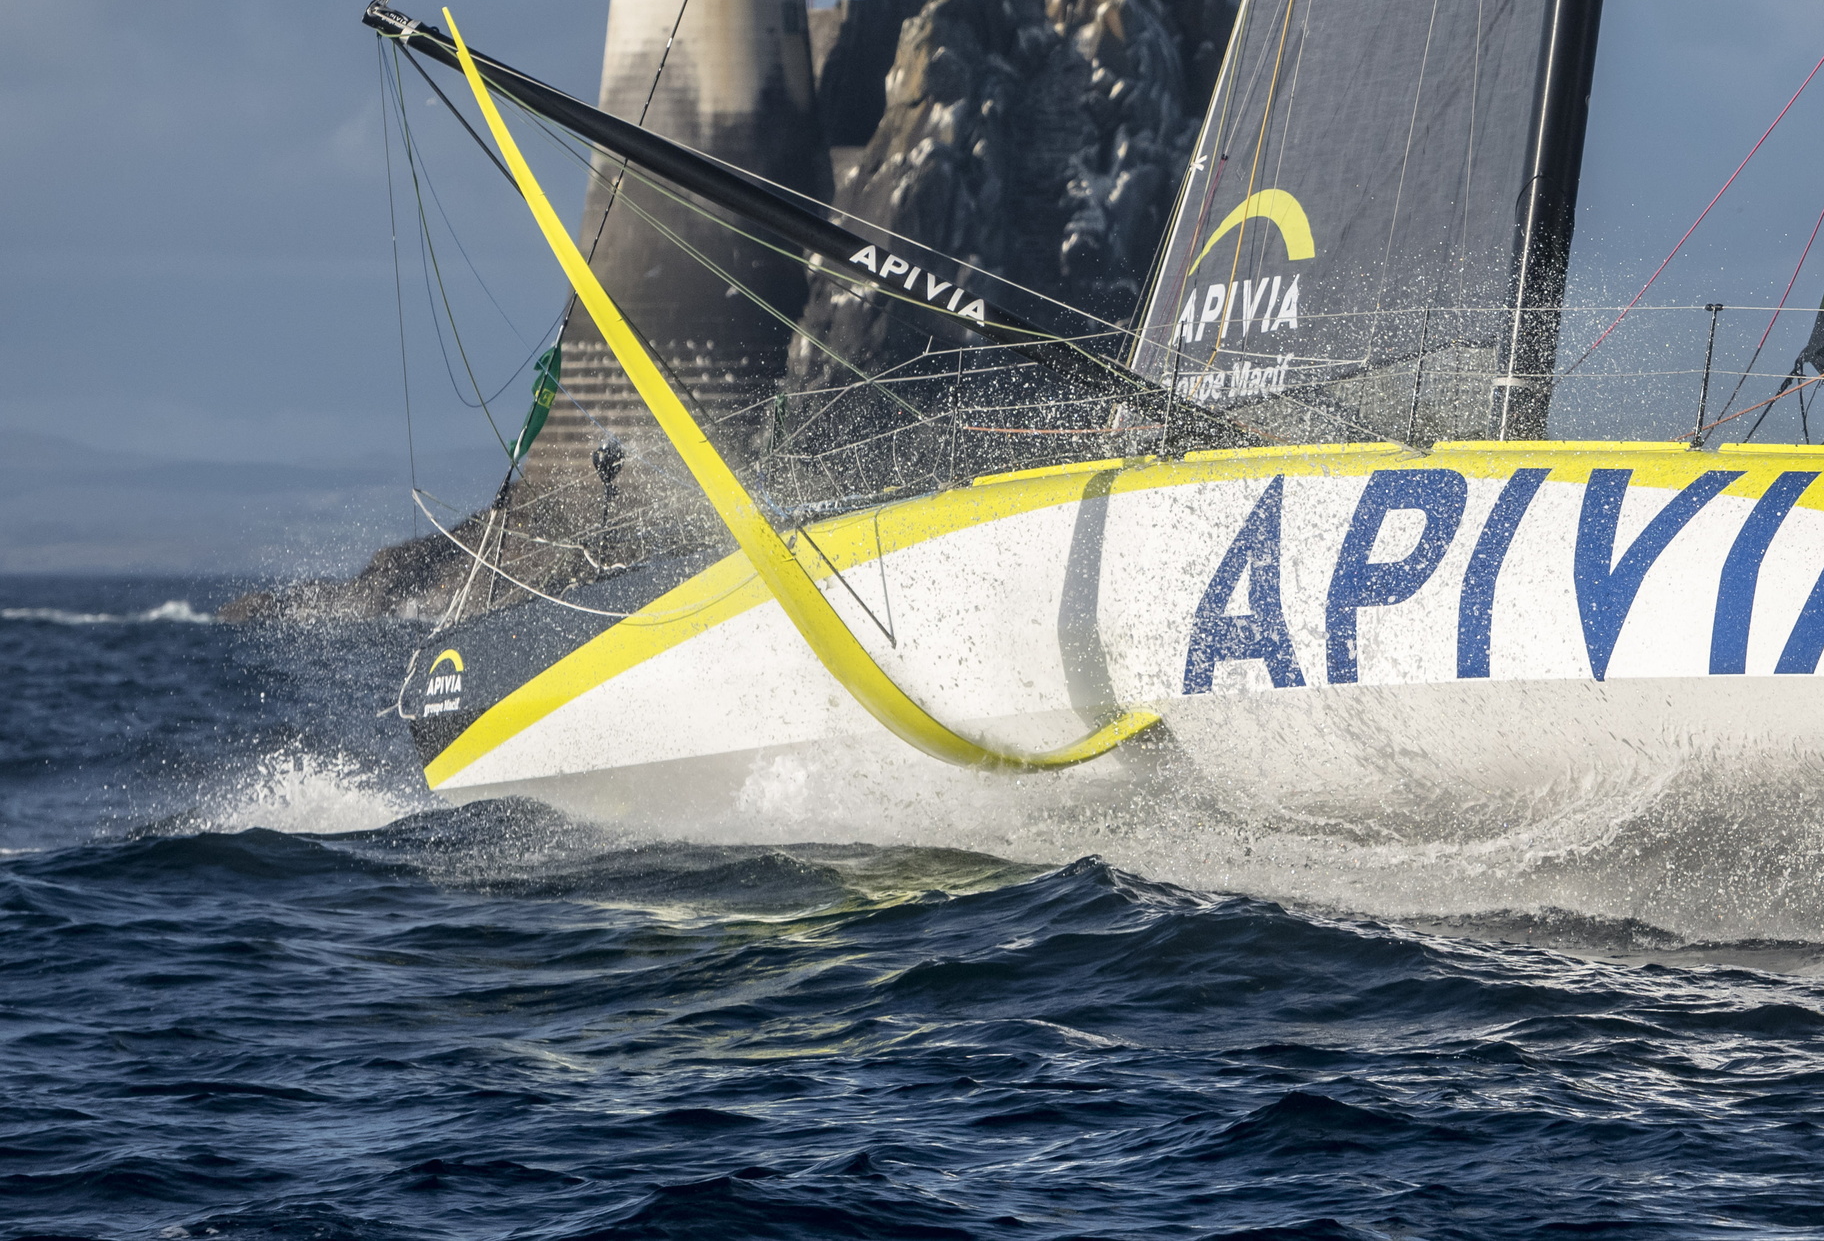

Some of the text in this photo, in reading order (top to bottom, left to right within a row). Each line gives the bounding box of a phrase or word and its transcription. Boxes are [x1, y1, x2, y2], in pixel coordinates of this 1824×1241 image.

[849, 244, 985, 327] APIVIA
[1171, 274, 1301, 347] APIVIA
[1229, 353, 1294, 397] Macif
[426, 674, 462, 696] APIVIA
